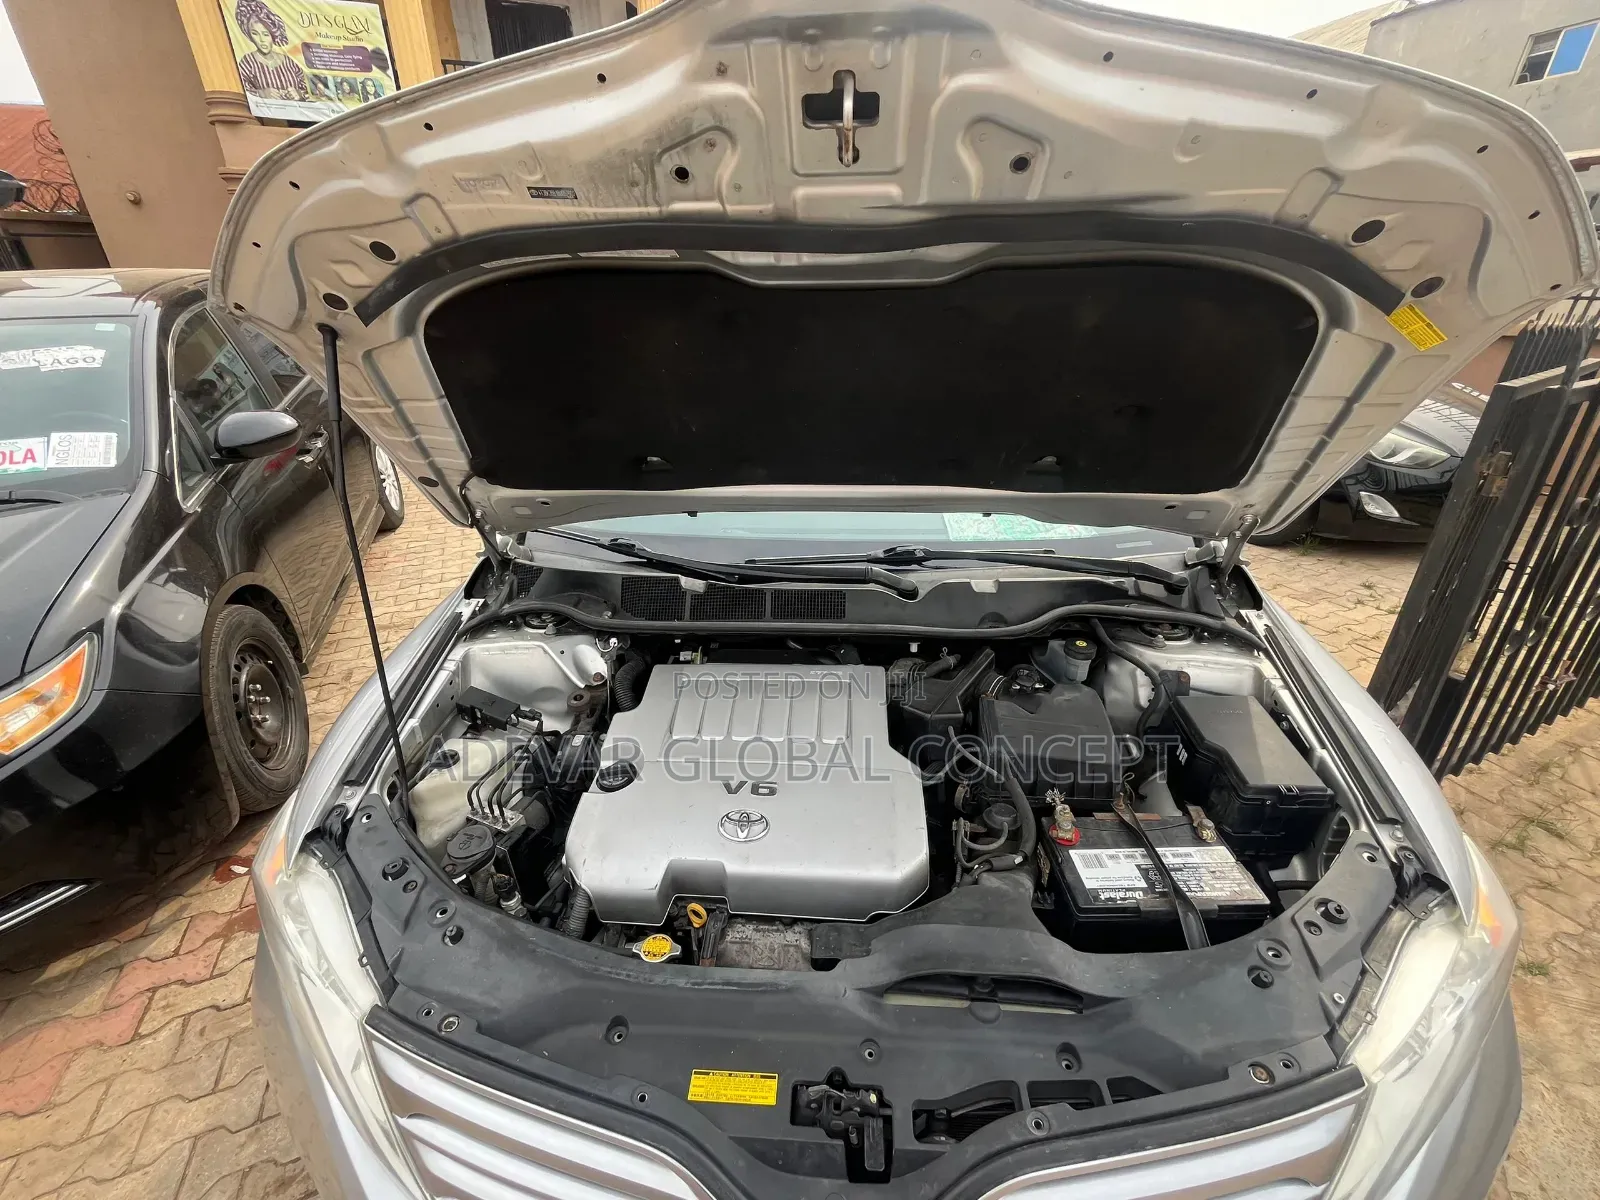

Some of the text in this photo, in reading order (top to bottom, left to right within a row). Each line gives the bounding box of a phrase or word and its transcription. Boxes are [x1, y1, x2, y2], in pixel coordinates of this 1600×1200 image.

[315, 31, 342, 42] Makeup
[721, 780, 778, 797] V6
[1098, 890, 1144, 901] Duralast
